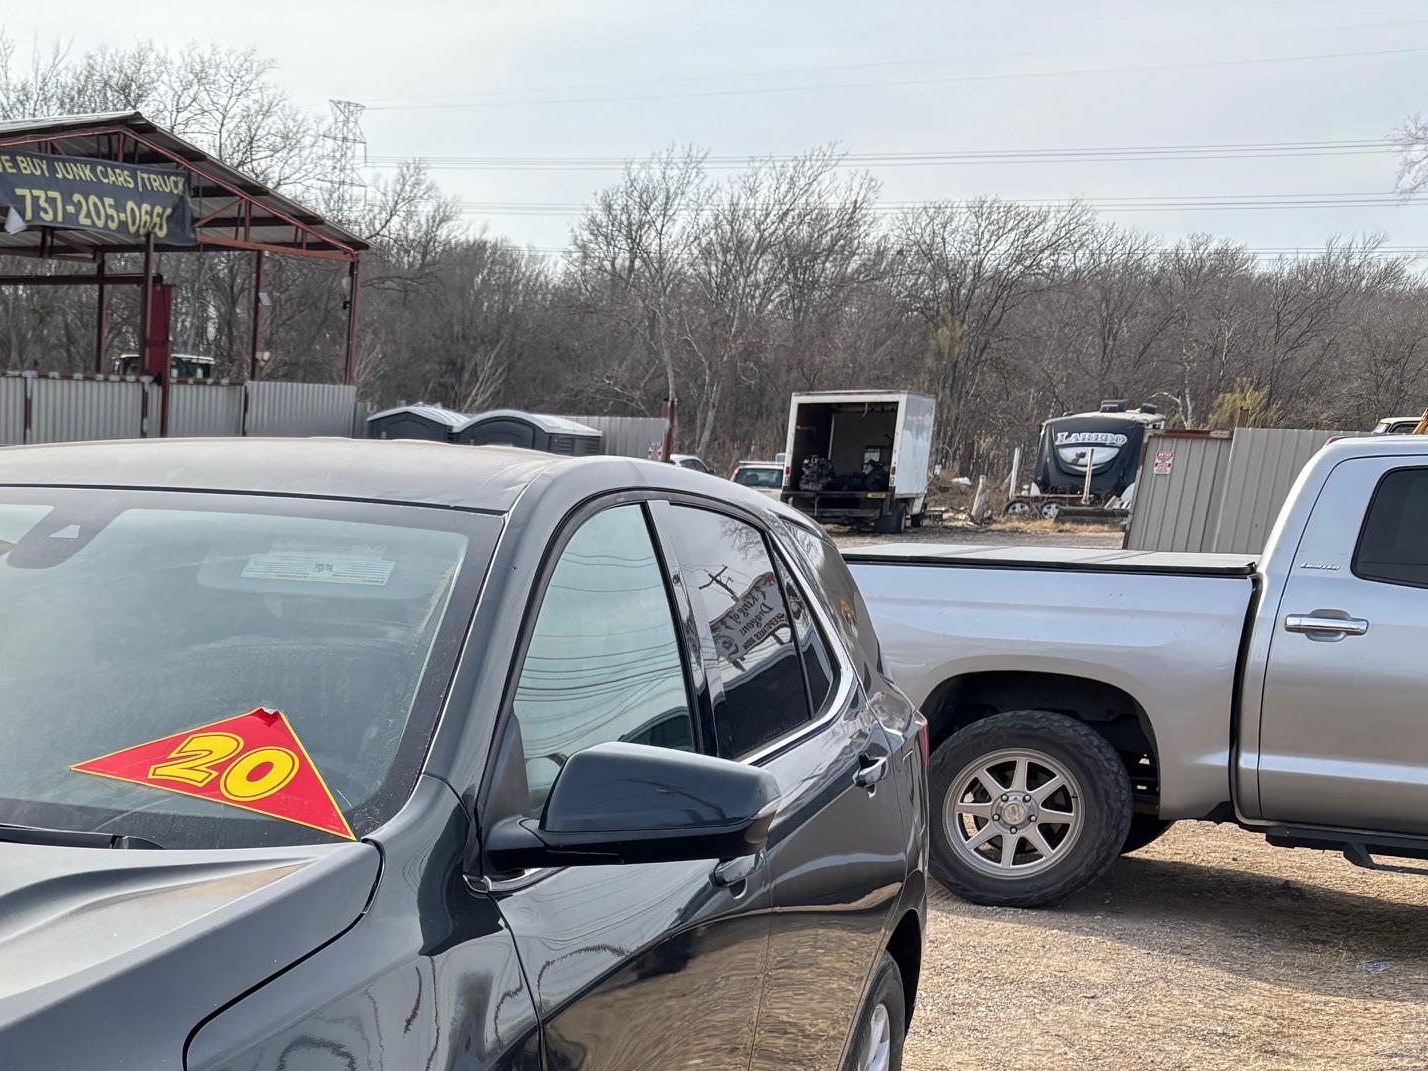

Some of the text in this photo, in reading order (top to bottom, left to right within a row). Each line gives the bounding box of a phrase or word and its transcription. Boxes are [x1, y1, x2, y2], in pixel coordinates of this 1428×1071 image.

[16, 156, 50, 177] BUY
[55, 161, 97, 182] JUNK
[97, 165, 135, 189] CARS
[147, 732, 300, 801] 20
